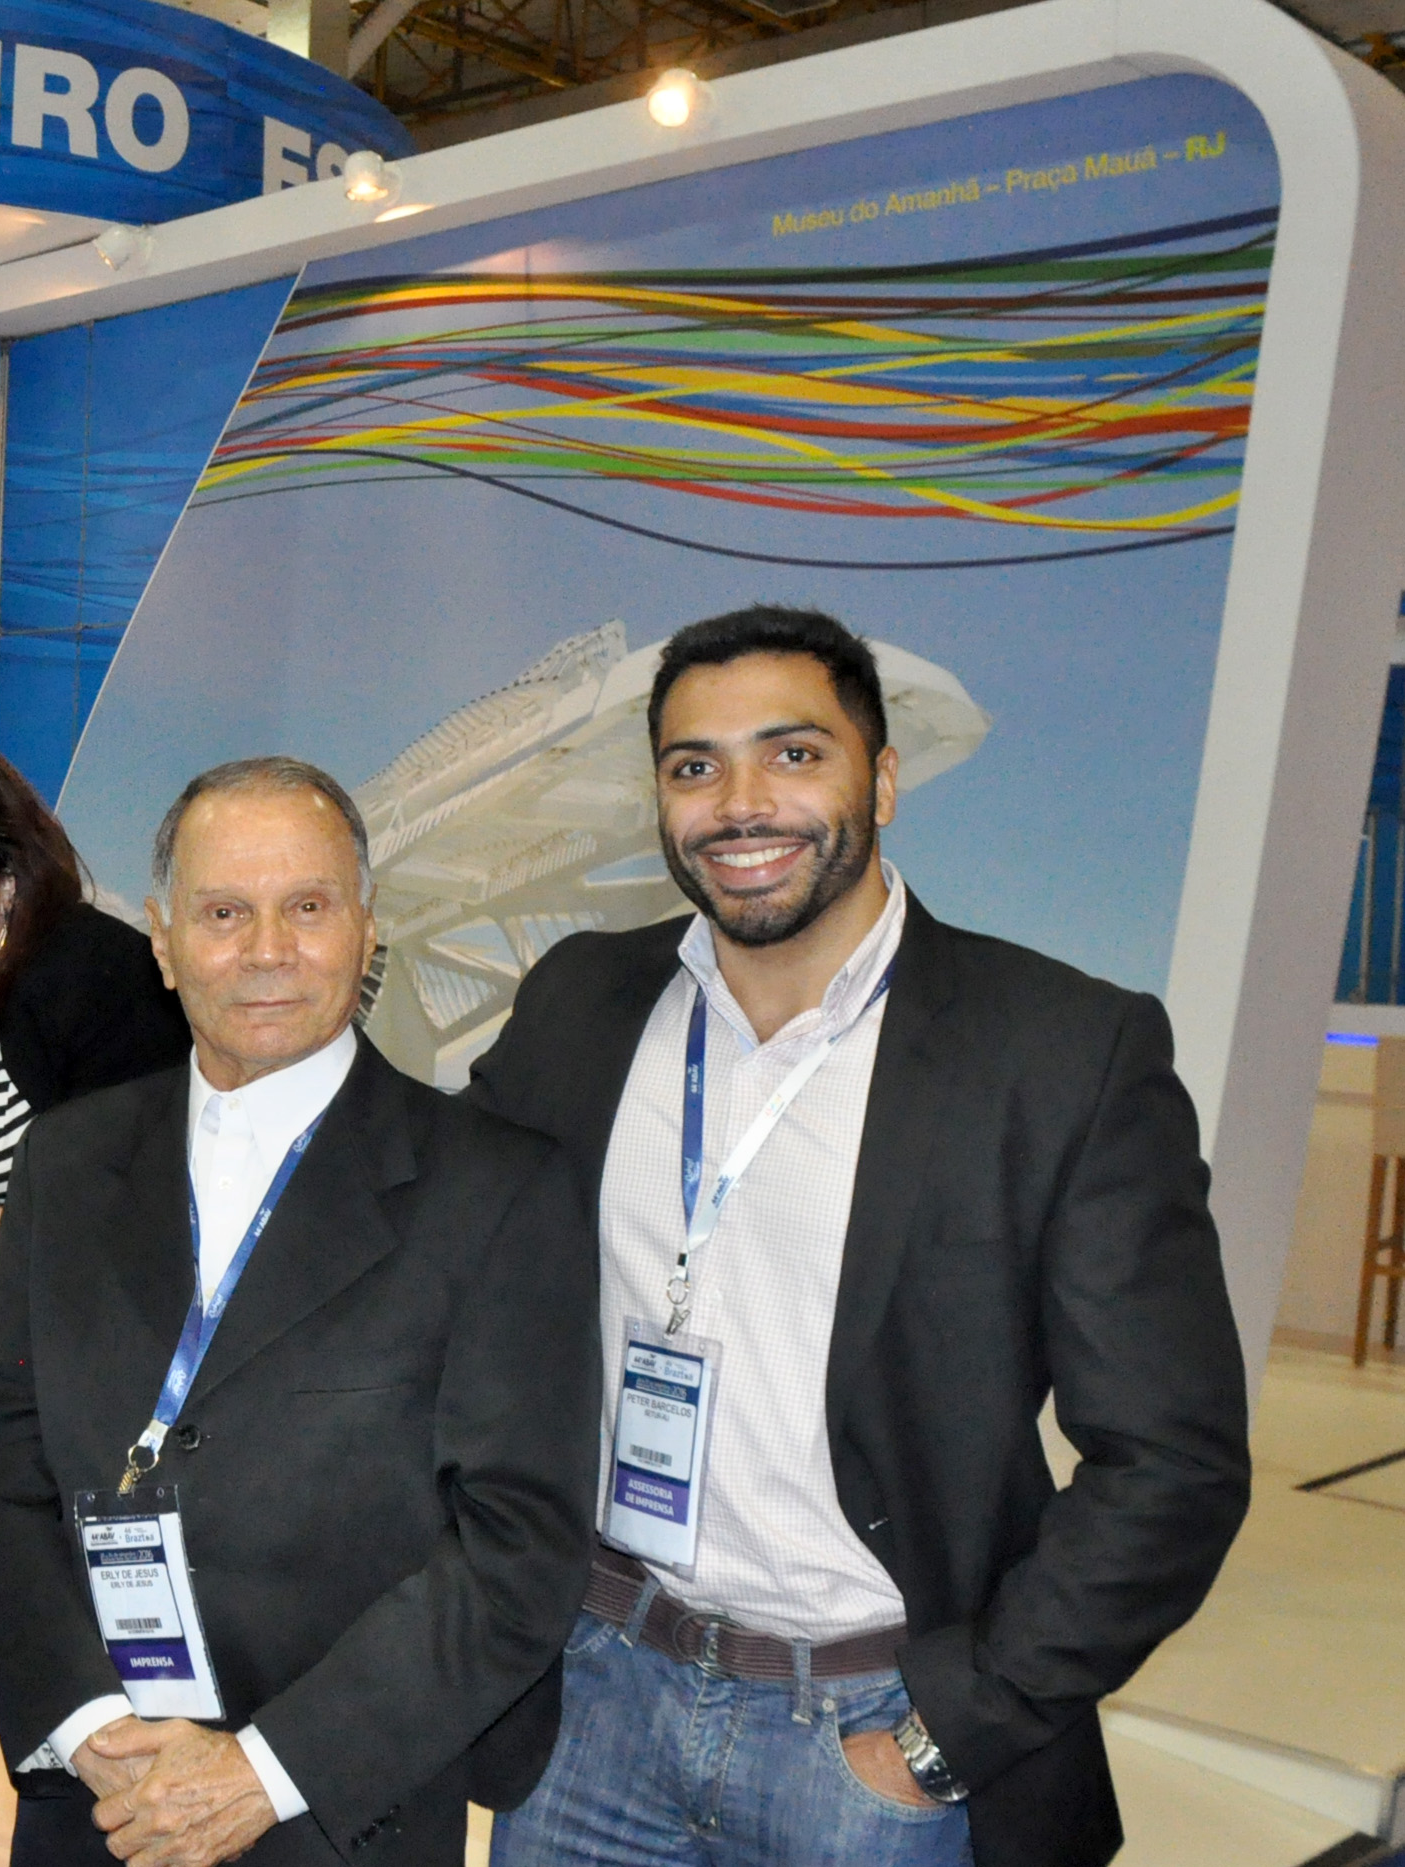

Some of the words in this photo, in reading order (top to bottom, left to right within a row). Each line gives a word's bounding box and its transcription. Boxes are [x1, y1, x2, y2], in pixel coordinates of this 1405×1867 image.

[772, 207, 844, 238] Museu
[849, 198, 880, 224] do
[884, 174, 981, 217] Amanhã
[1005, 163, 1079, 194] Praça
[1084, 144, 1158, 181] Mauá
[1185, 130, 1227, 162] RJ
[626, 1393, 650, 1408] PETER
[651, 1400, 692, 1418] BARCELOS
[628, 1478, 673, 1501] ASSESSORIA
[624, 1492, 634, 1504] DE
[635, 1495, 674, 1517] IMPRENSA
[101, 1570, 120, 1580] ERLY
[122, 1570, 132, 1579] DE
[134, 1568, 160, 1578] JESUS
[130, 1656, 175, 1668] IMPRENSA
